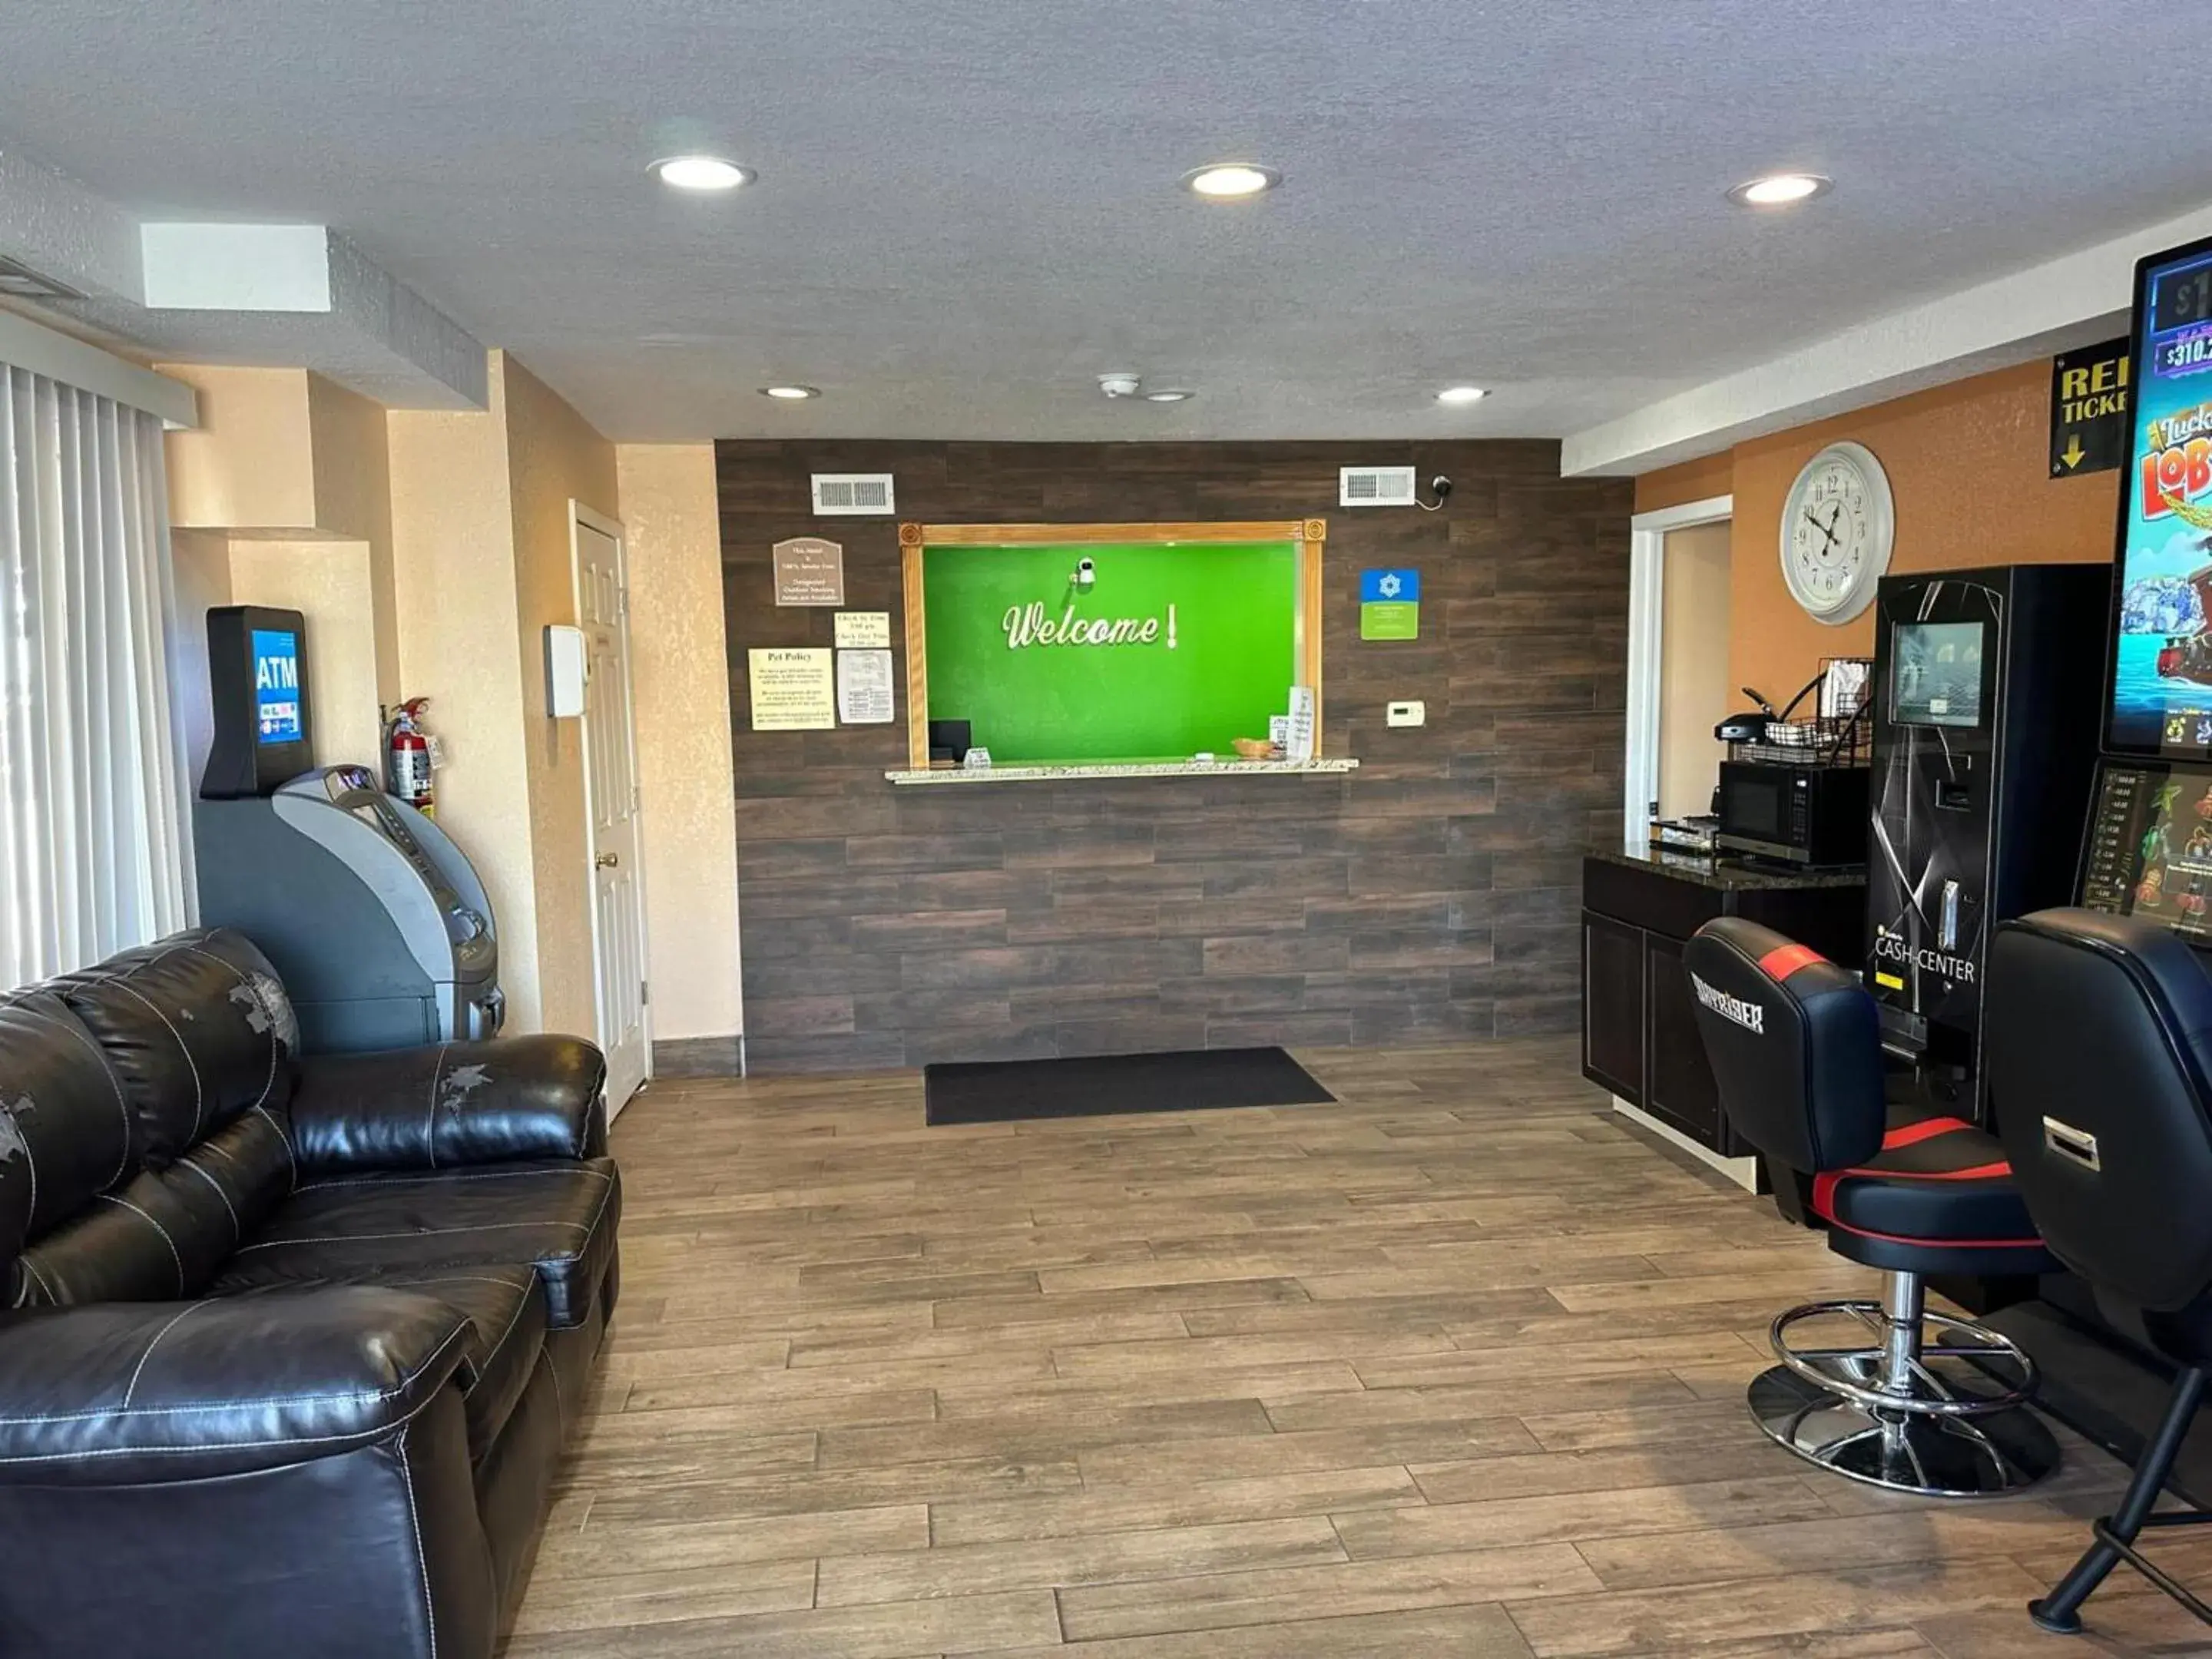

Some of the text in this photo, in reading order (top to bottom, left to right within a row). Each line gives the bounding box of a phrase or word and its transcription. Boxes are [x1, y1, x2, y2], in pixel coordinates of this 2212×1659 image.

[257, 657, 298, 690] ATM
[768, 652, 812, 663] Pet Policy
[1918, 949, 1975, 984] CENTER
